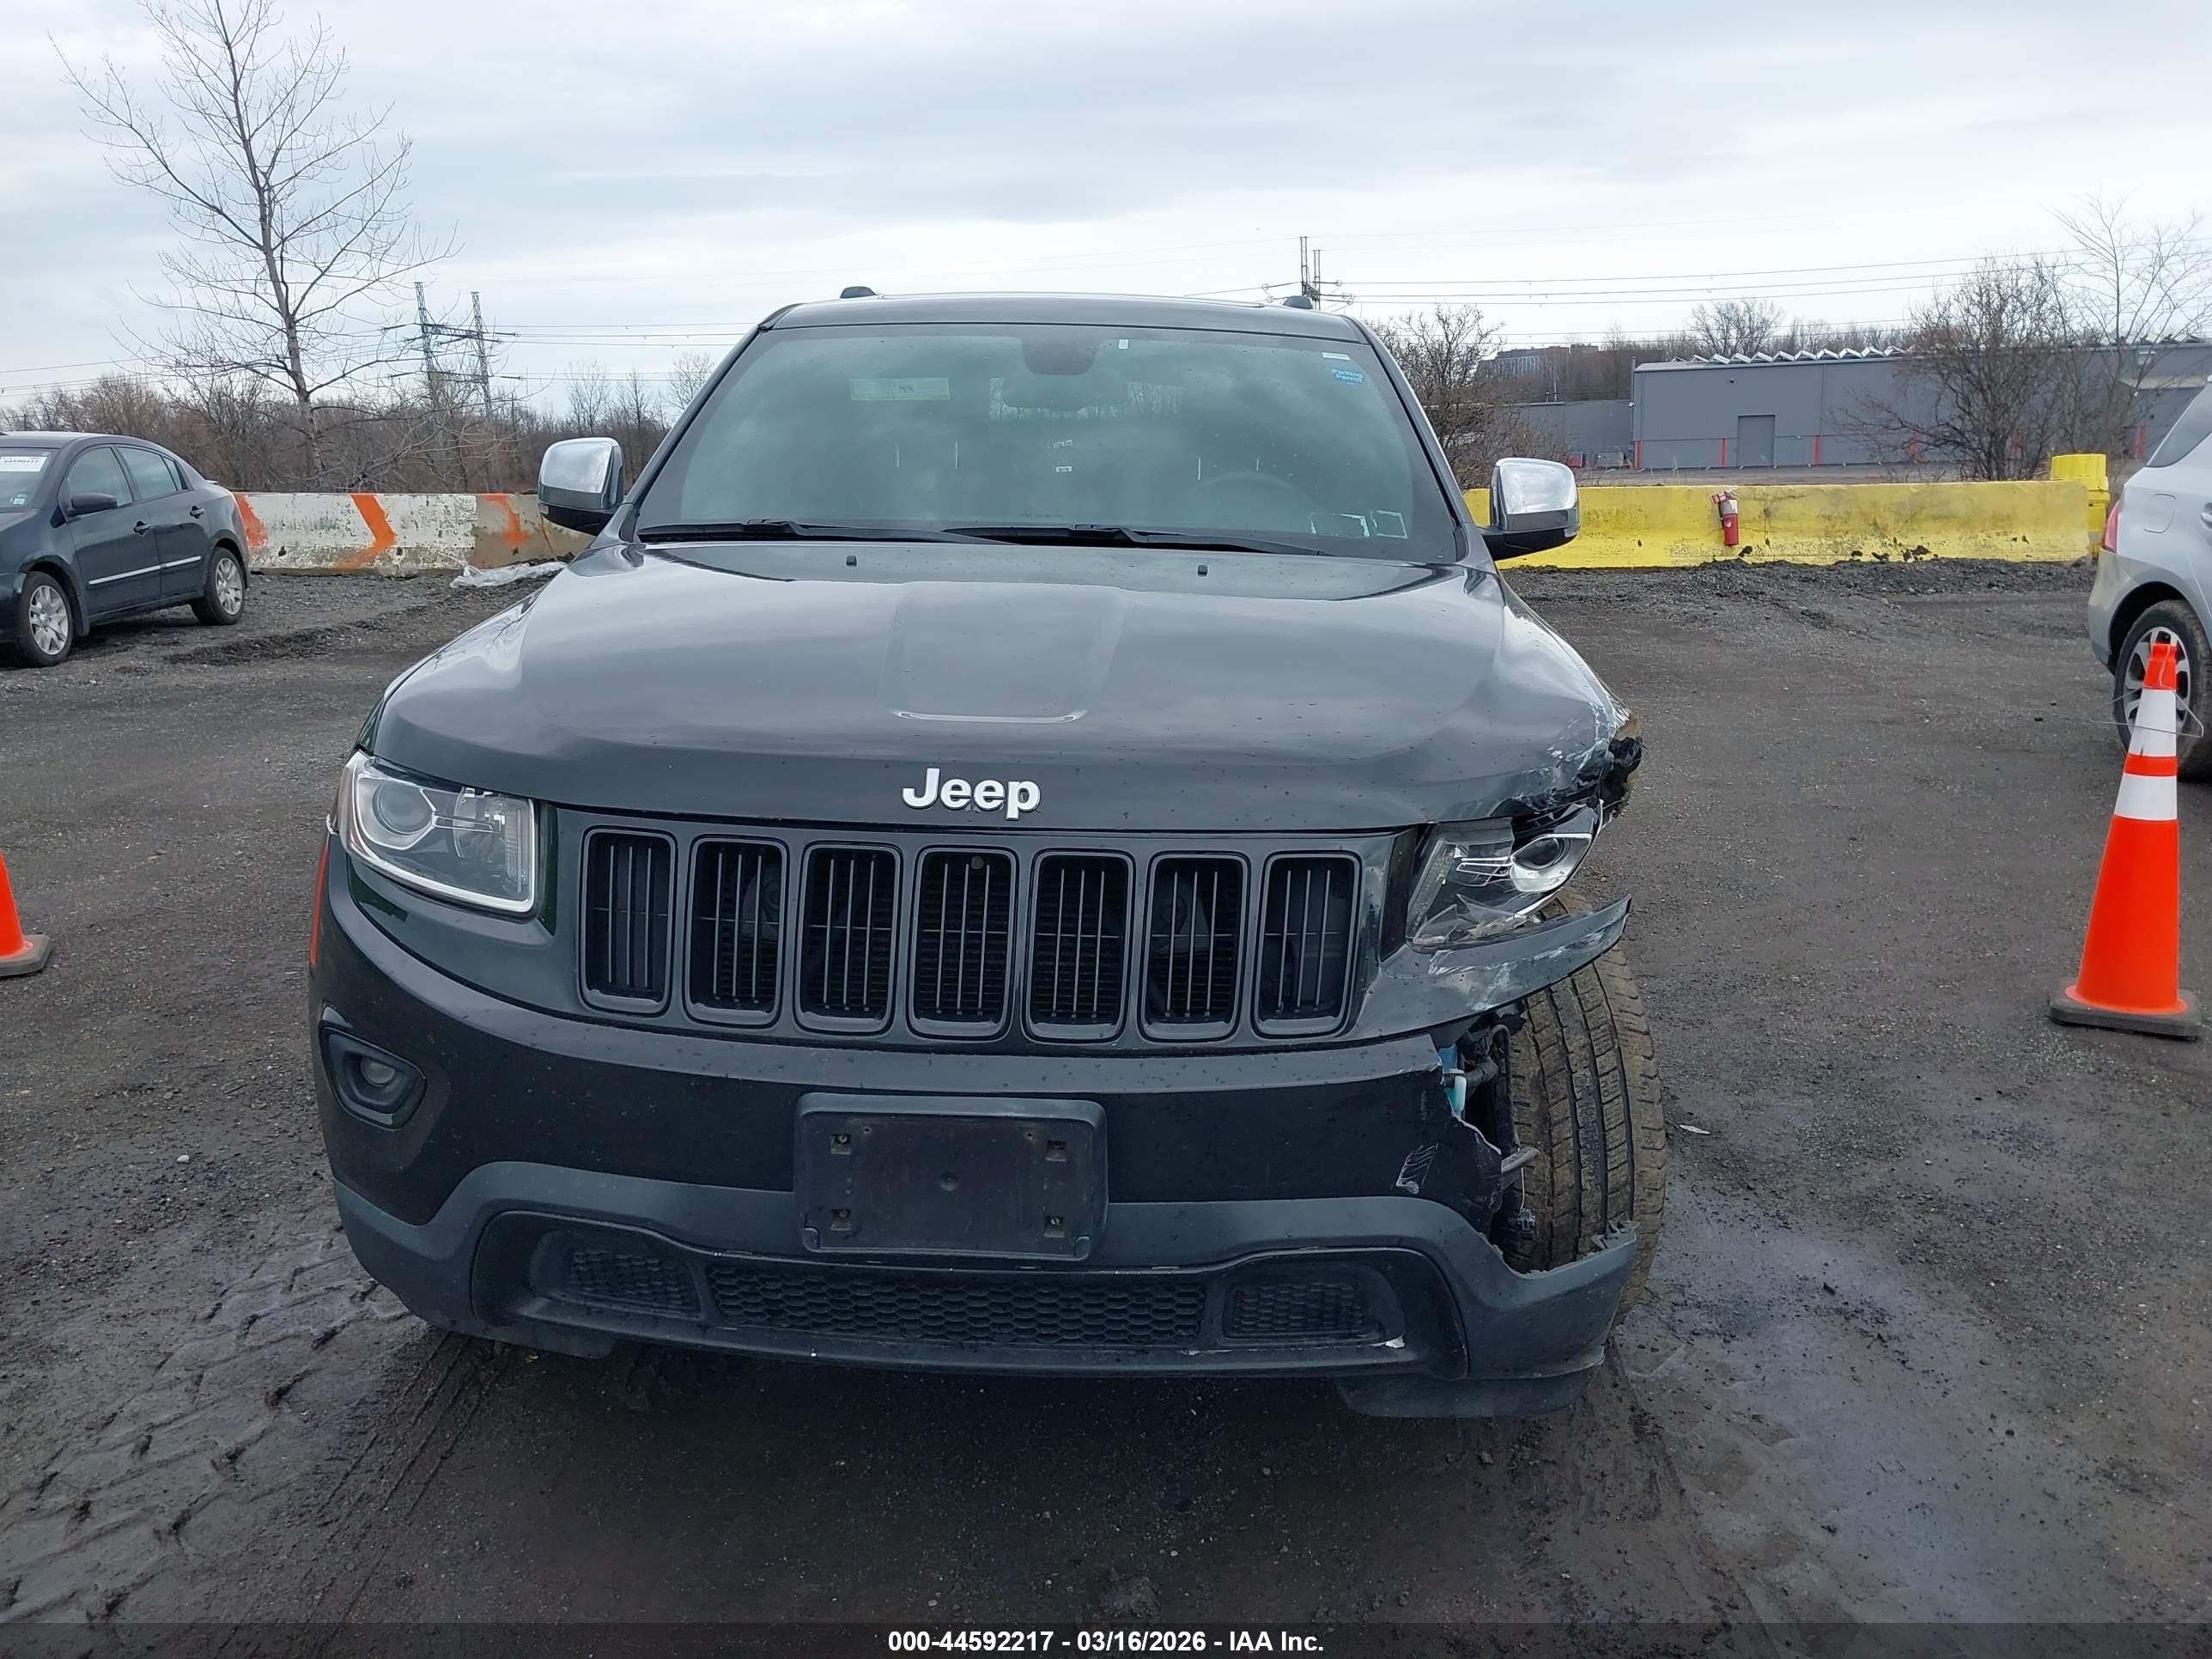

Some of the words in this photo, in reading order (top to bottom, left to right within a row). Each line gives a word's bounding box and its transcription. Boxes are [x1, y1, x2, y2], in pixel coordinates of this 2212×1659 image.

[1332, 368, 1363, 379] Parking
[1336, 374, 1363, 383] Permit
[902, 768, 1041, 821] Jeep
